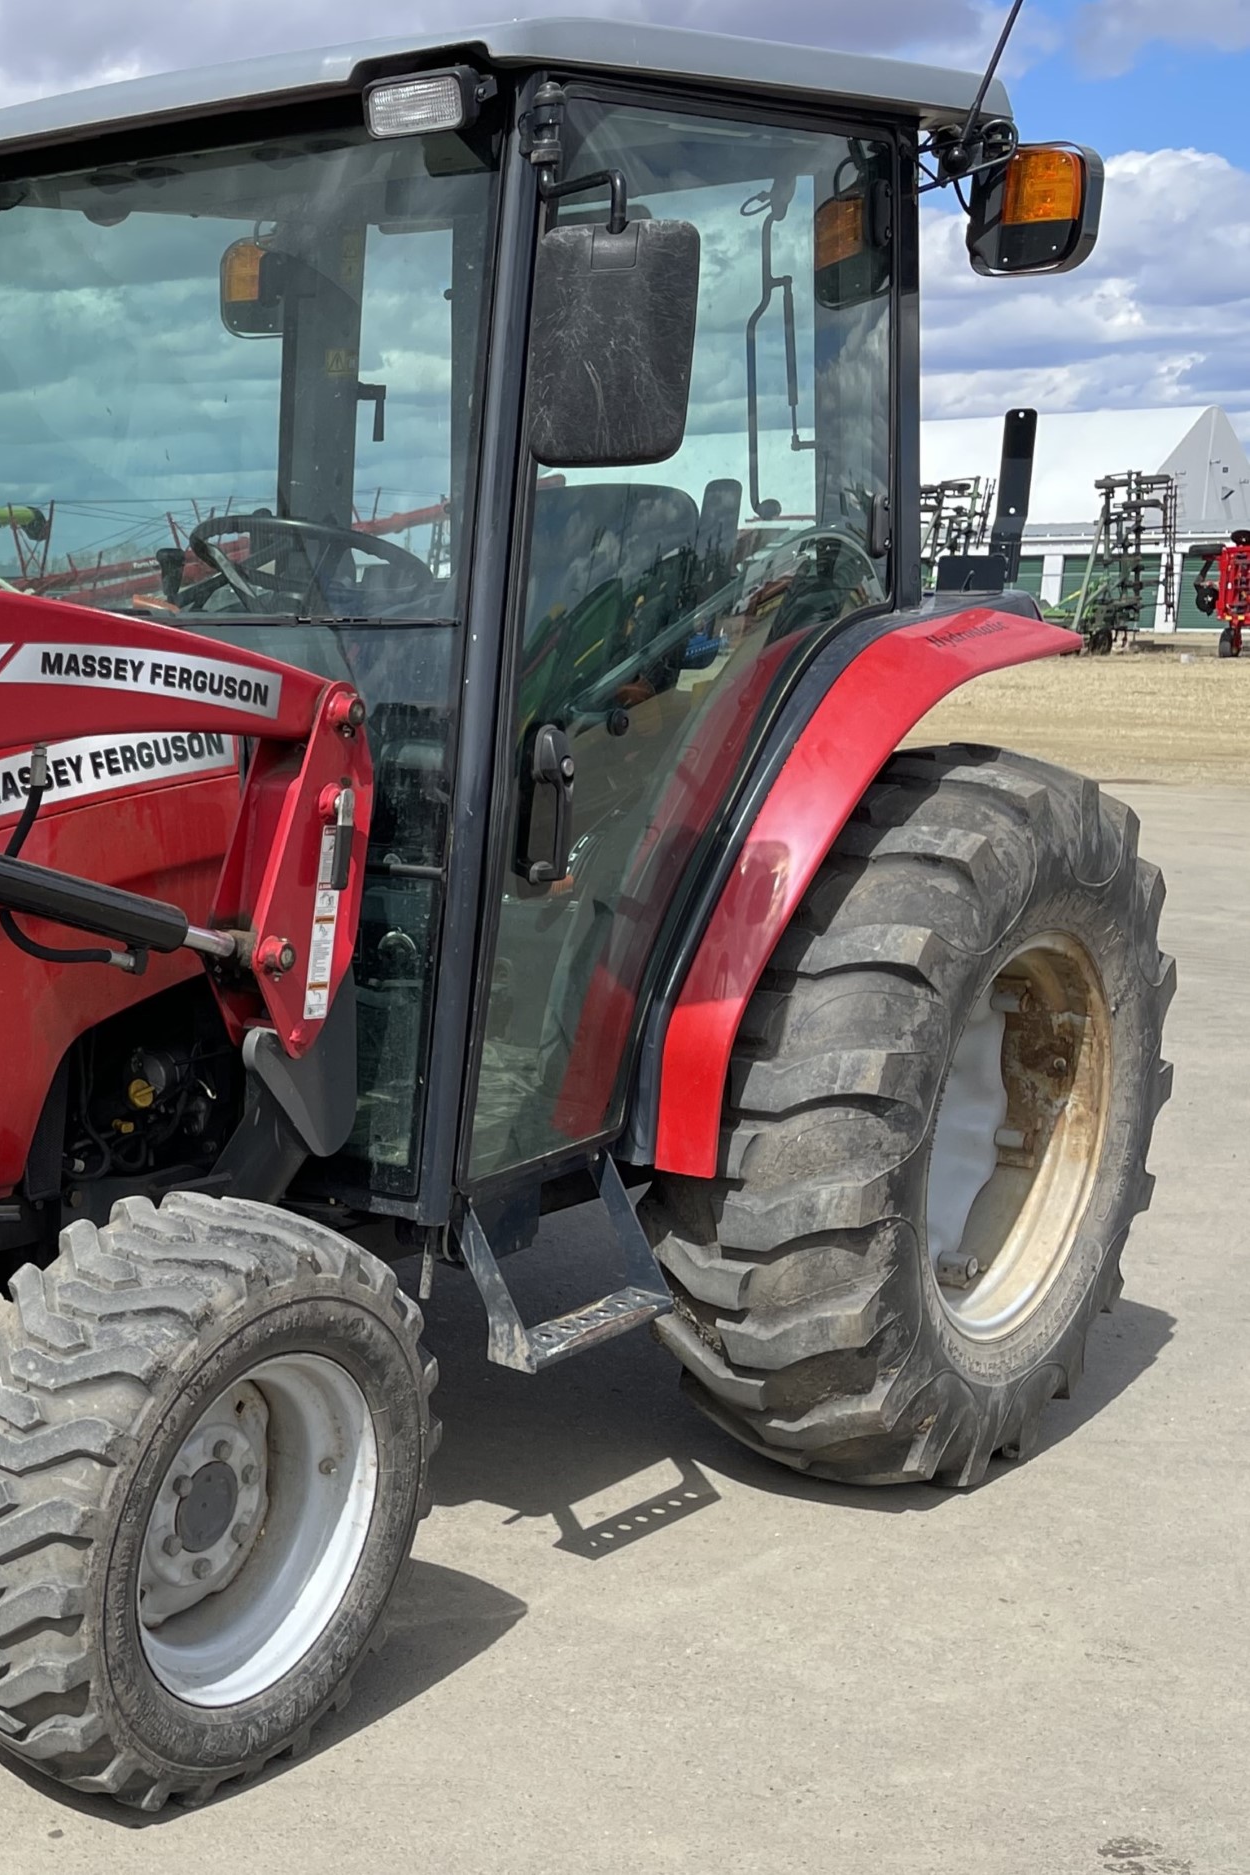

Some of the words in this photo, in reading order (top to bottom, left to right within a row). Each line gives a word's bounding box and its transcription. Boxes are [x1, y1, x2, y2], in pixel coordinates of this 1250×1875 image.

[41, 651, 145, 682] MASSEY
[150, 662, 269, 706] FERGUSON
[89, 732, 225, 780] FERGUSON
